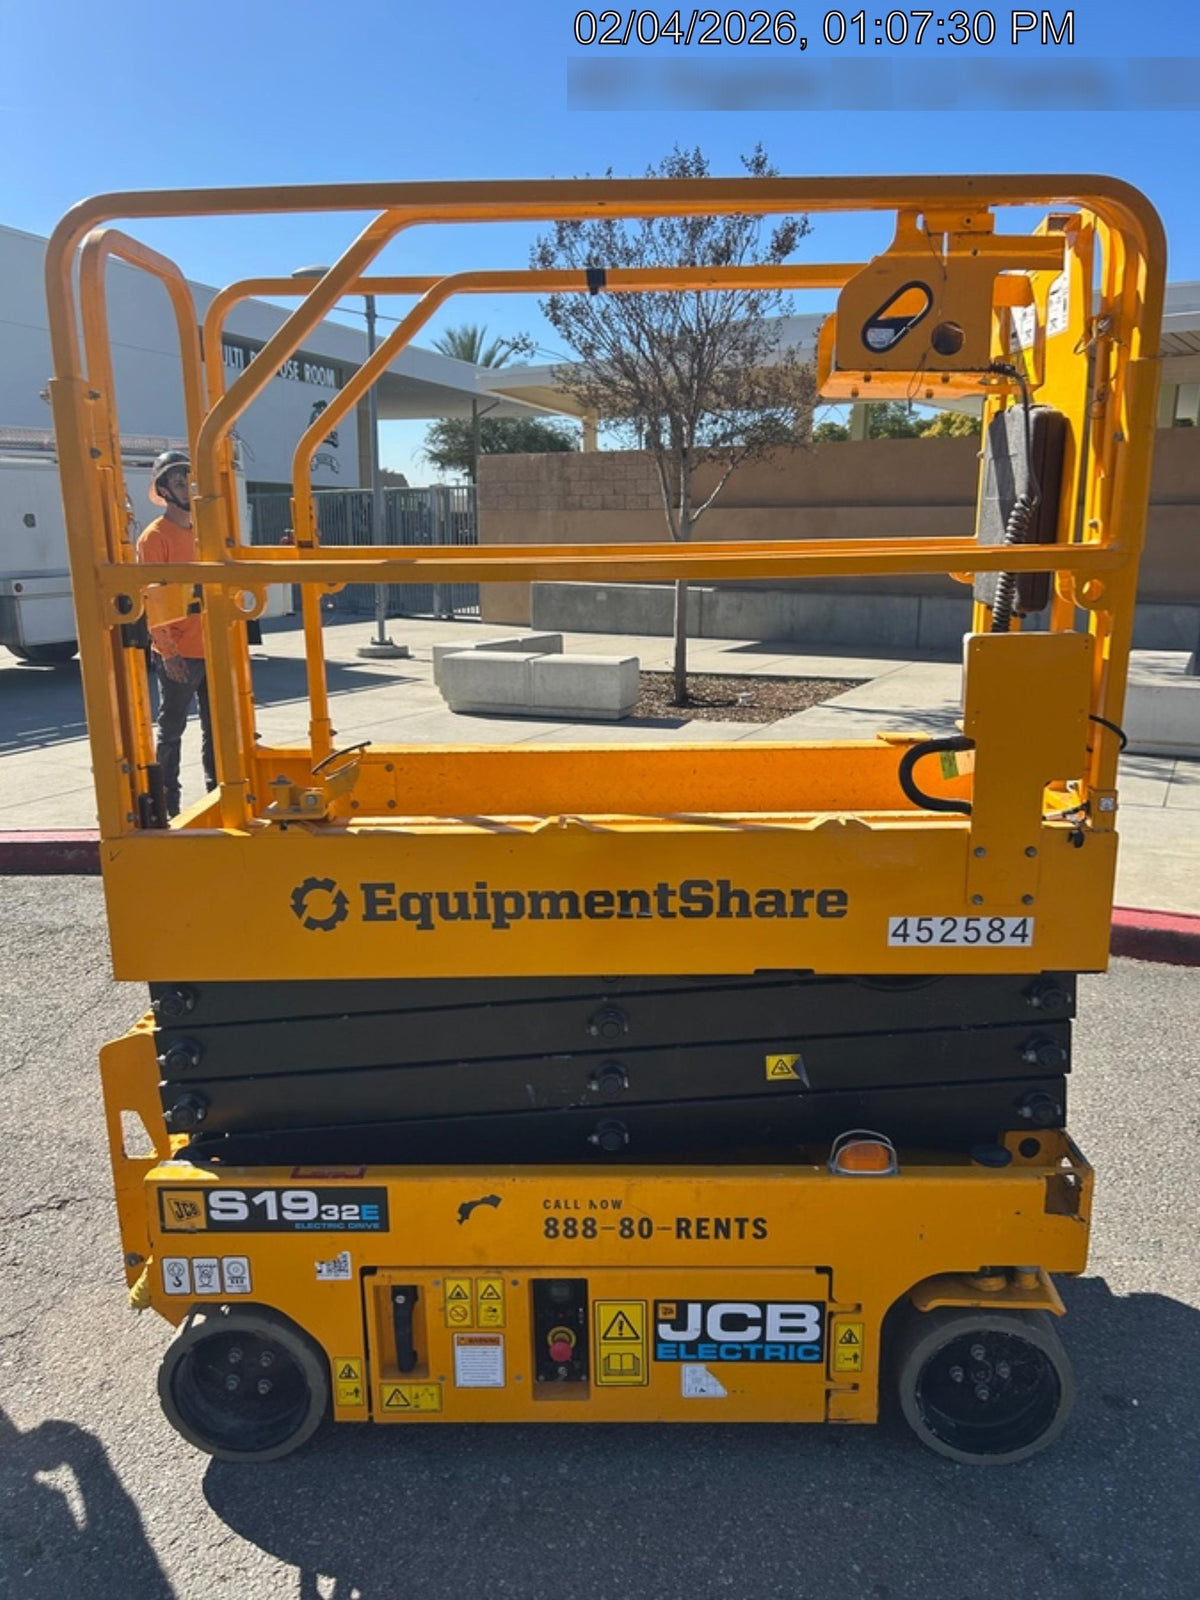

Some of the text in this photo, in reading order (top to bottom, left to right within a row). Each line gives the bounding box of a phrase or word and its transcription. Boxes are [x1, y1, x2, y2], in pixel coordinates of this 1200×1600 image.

[222, 343, 244, 370] ULTI
[303, 363, 336, 389] ROOM
[361, 879, 848, 930] EquipmentShare
[891, 917, 1031, 945] 452584
[543, 1199, 581, 1210] CALL
[657, 1303, 820, 1342] JCB
[656, 1344, 820, 1361] ELECTRIC
